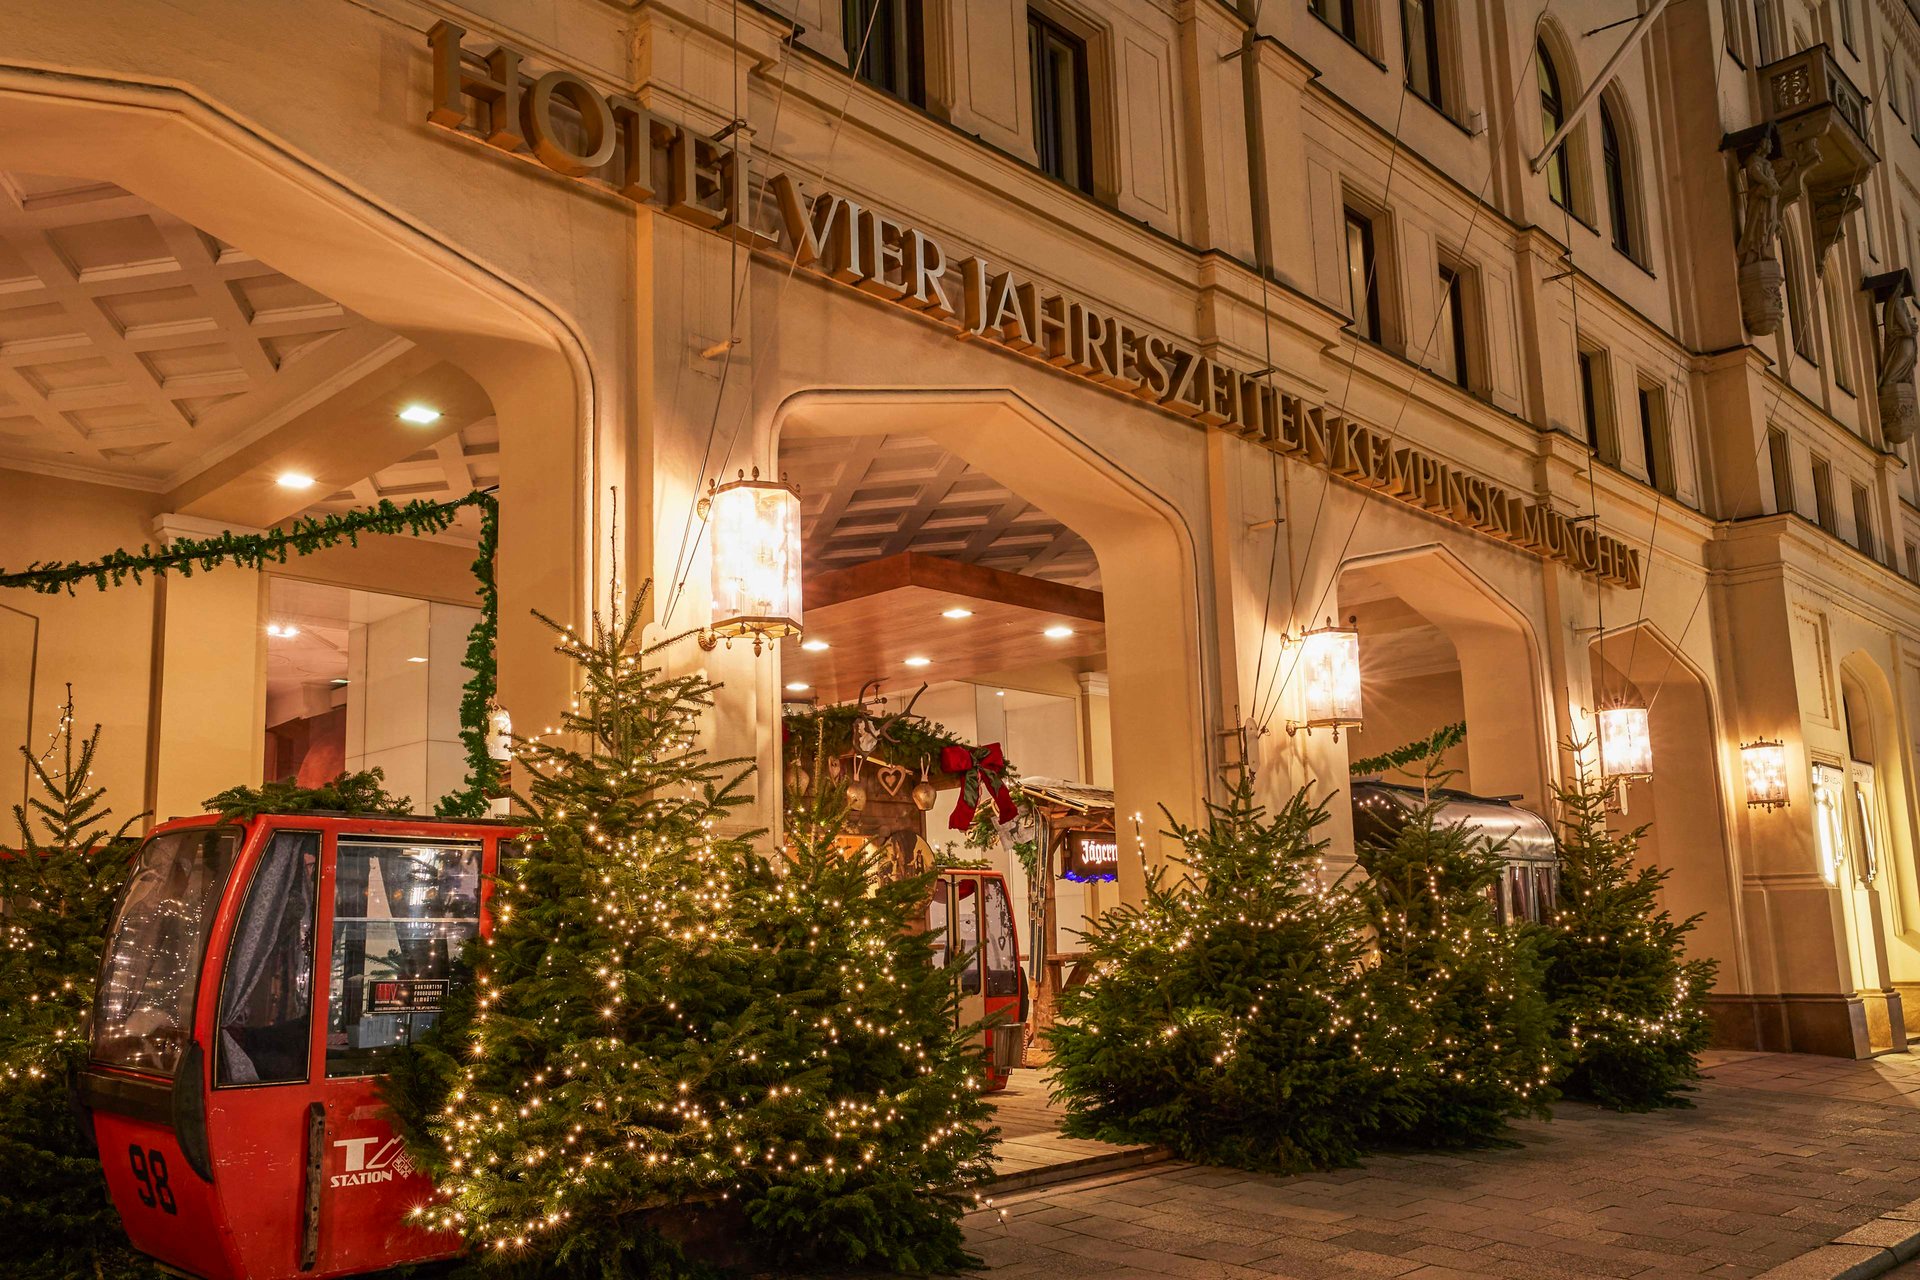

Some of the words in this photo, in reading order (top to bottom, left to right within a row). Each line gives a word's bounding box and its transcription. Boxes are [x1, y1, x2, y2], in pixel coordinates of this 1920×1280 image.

[427, 18, 780, 248] HOTEL
[769, 173, 955, 316] VIER
[958, 256, 1330, 464] JAHRESZEITEN
[1327, 417, 1512, 538] KEMPINSKI
[1509, 498, 1641, 589] MÜNCHEN
[1021, 1029, 1029, 1065] CARVING
[129, 1144, 177, 1216] 98
[330, 1170, 393, 1188] STATION
